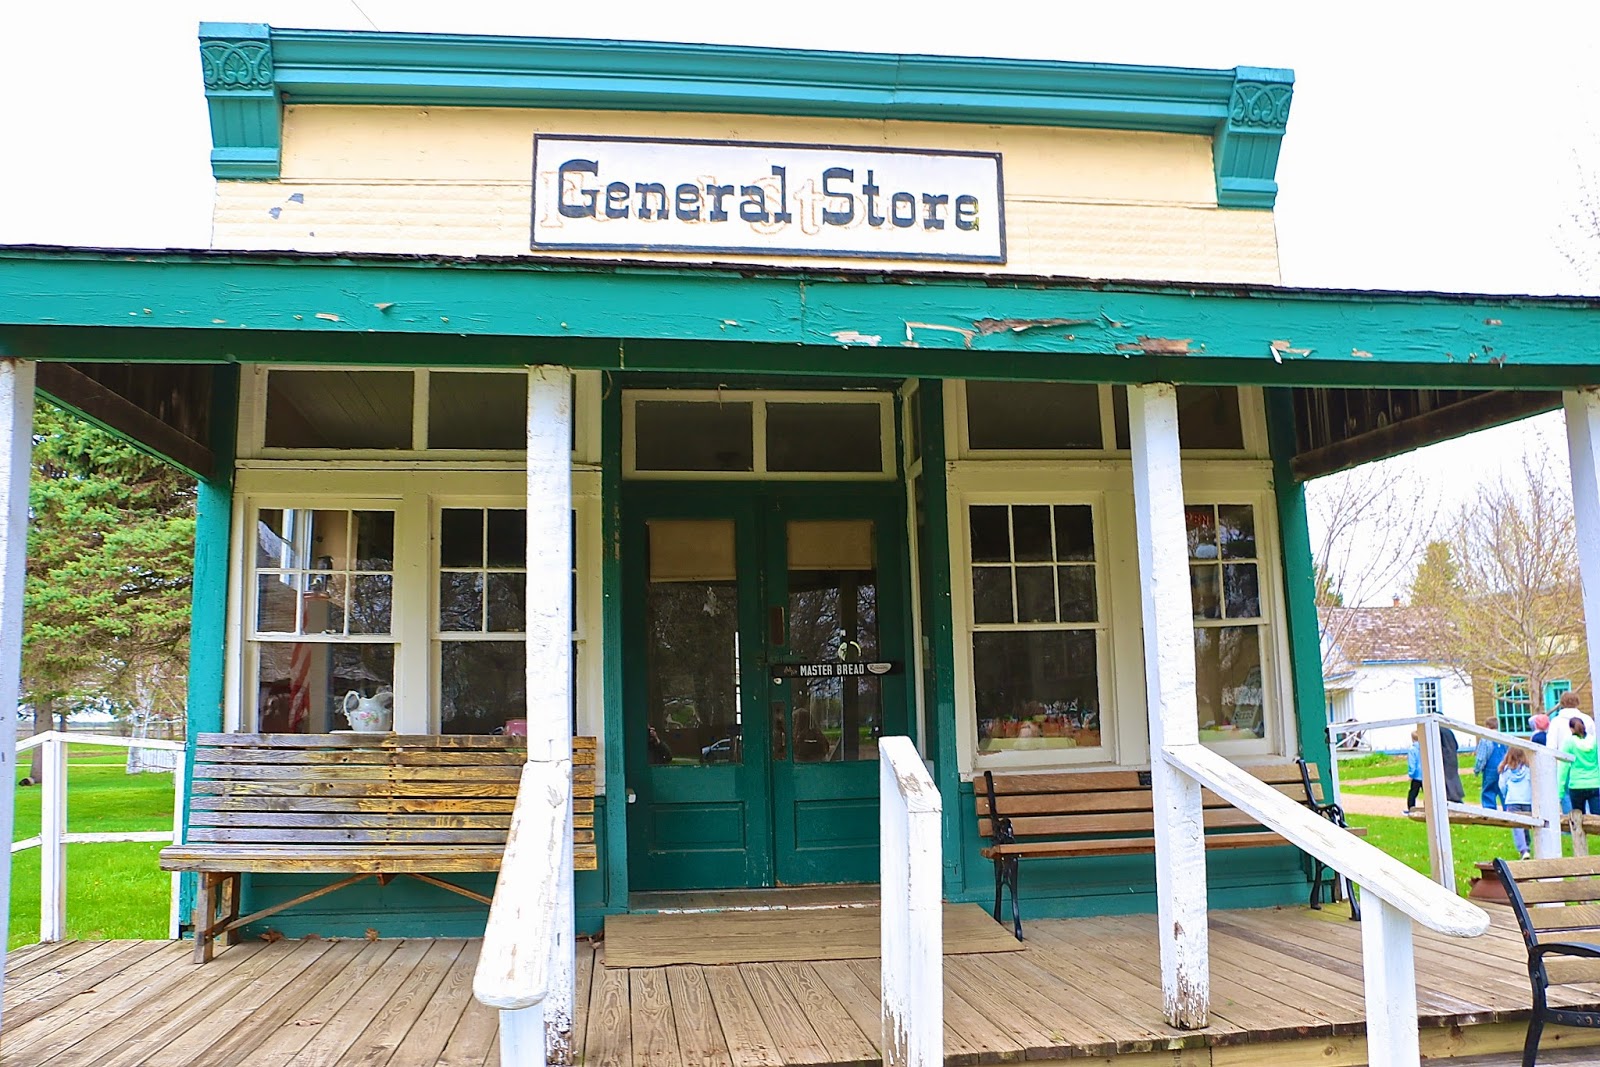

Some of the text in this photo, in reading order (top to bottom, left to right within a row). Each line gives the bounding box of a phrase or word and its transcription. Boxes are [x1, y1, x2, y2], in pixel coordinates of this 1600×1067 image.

[558, 158, 792, 224] General
[822, 166, 980, 232] Store
[1185, 512, 1210, 525] PEN
[800, 664, 833, 676] MASTER
[836, 663, 865, 675] BREAD
